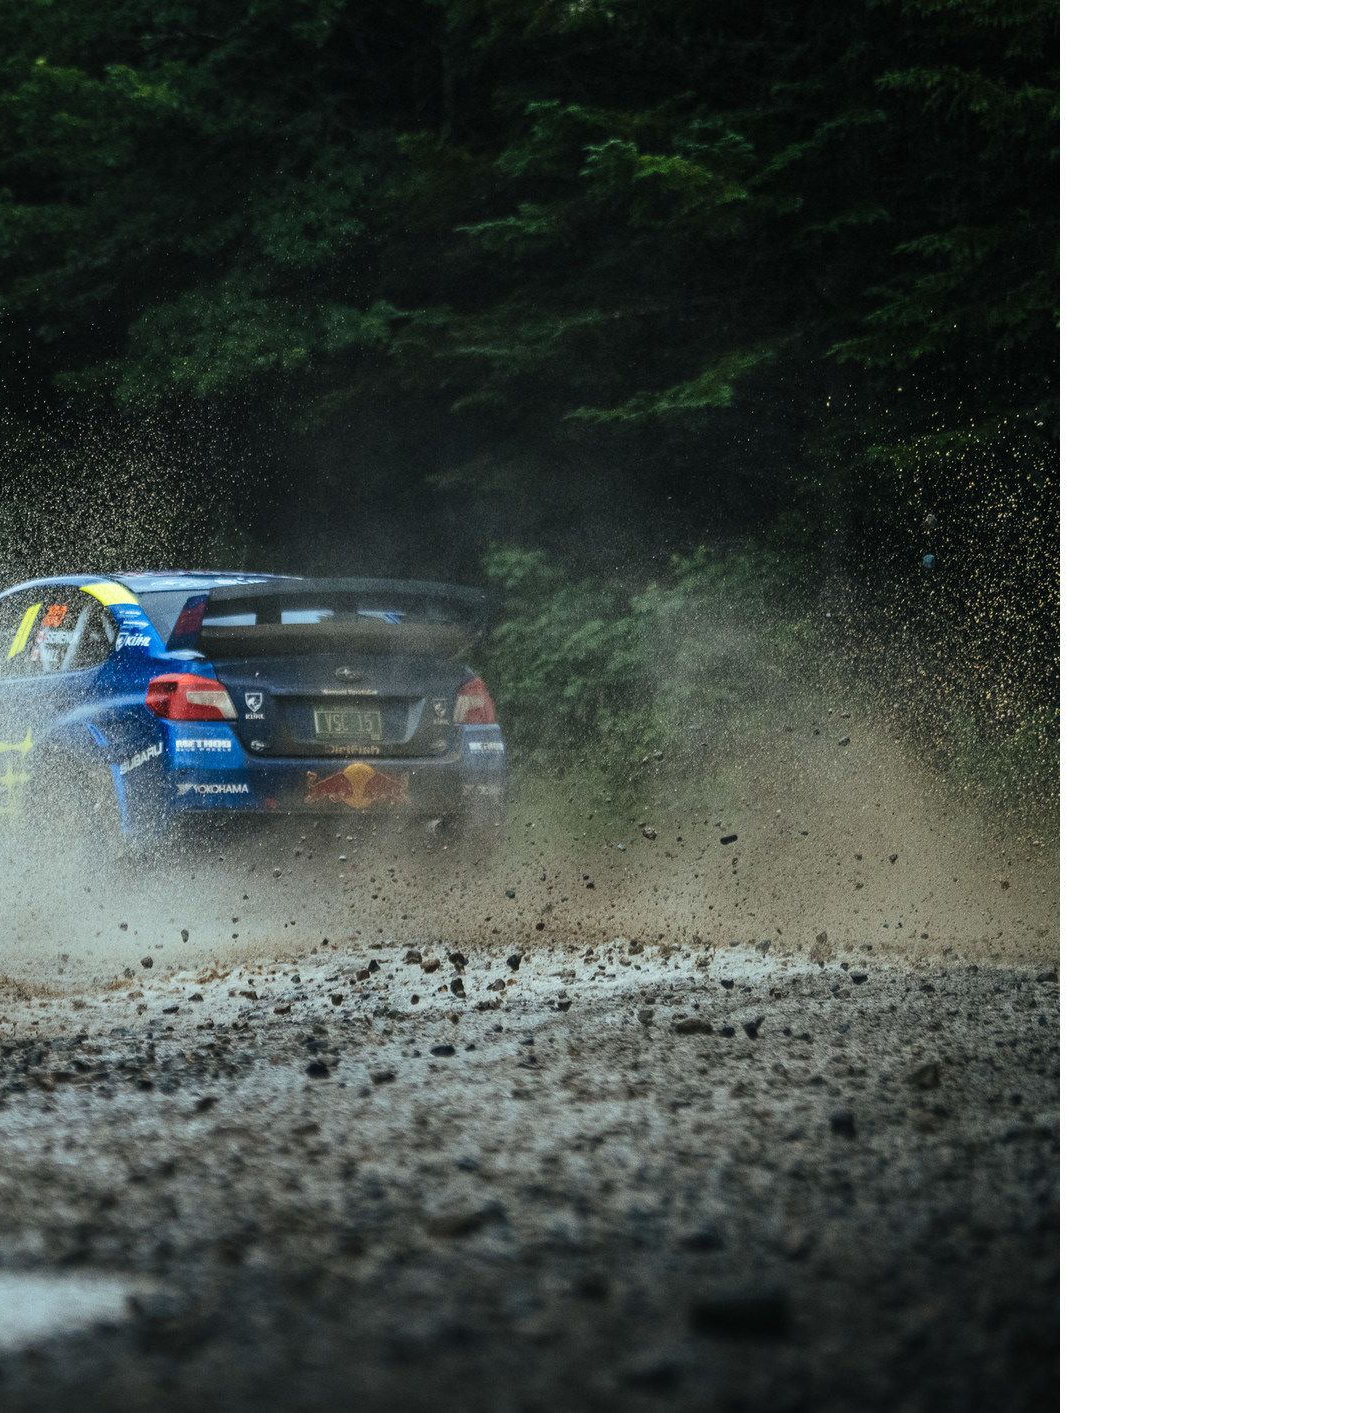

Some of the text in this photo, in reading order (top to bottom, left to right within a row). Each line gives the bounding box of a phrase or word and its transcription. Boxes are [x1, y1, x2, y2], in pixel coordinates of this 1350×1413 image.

[175, 739, 232, 748] METHOD
[119, 742, 163, 775] SUBARU
[192, 783, 249, 794] YOKOHAMA
